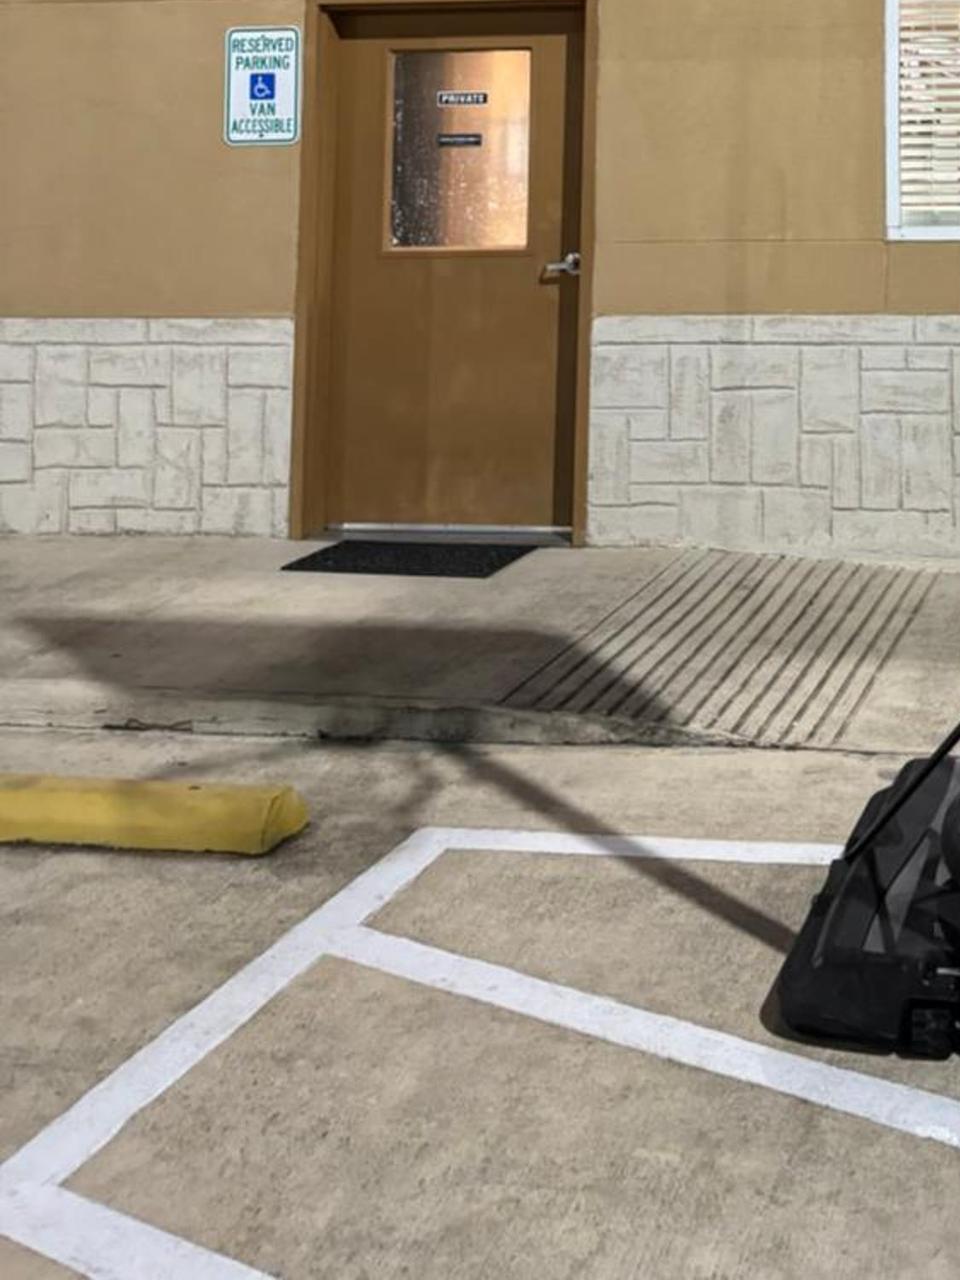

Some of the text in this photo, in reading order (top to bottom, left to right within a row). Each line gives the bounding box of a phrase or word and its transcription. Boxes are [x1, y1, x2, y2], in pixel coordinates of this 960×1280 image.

[232, 38, 294, 53] RESERVED
[235, 55, 290, 70] PARKING
[442, 94, 484, 104] PRIVATE
[250, 102, 276, 116] VAN
[232, 119, 292, 134] ACCESSIBLE
